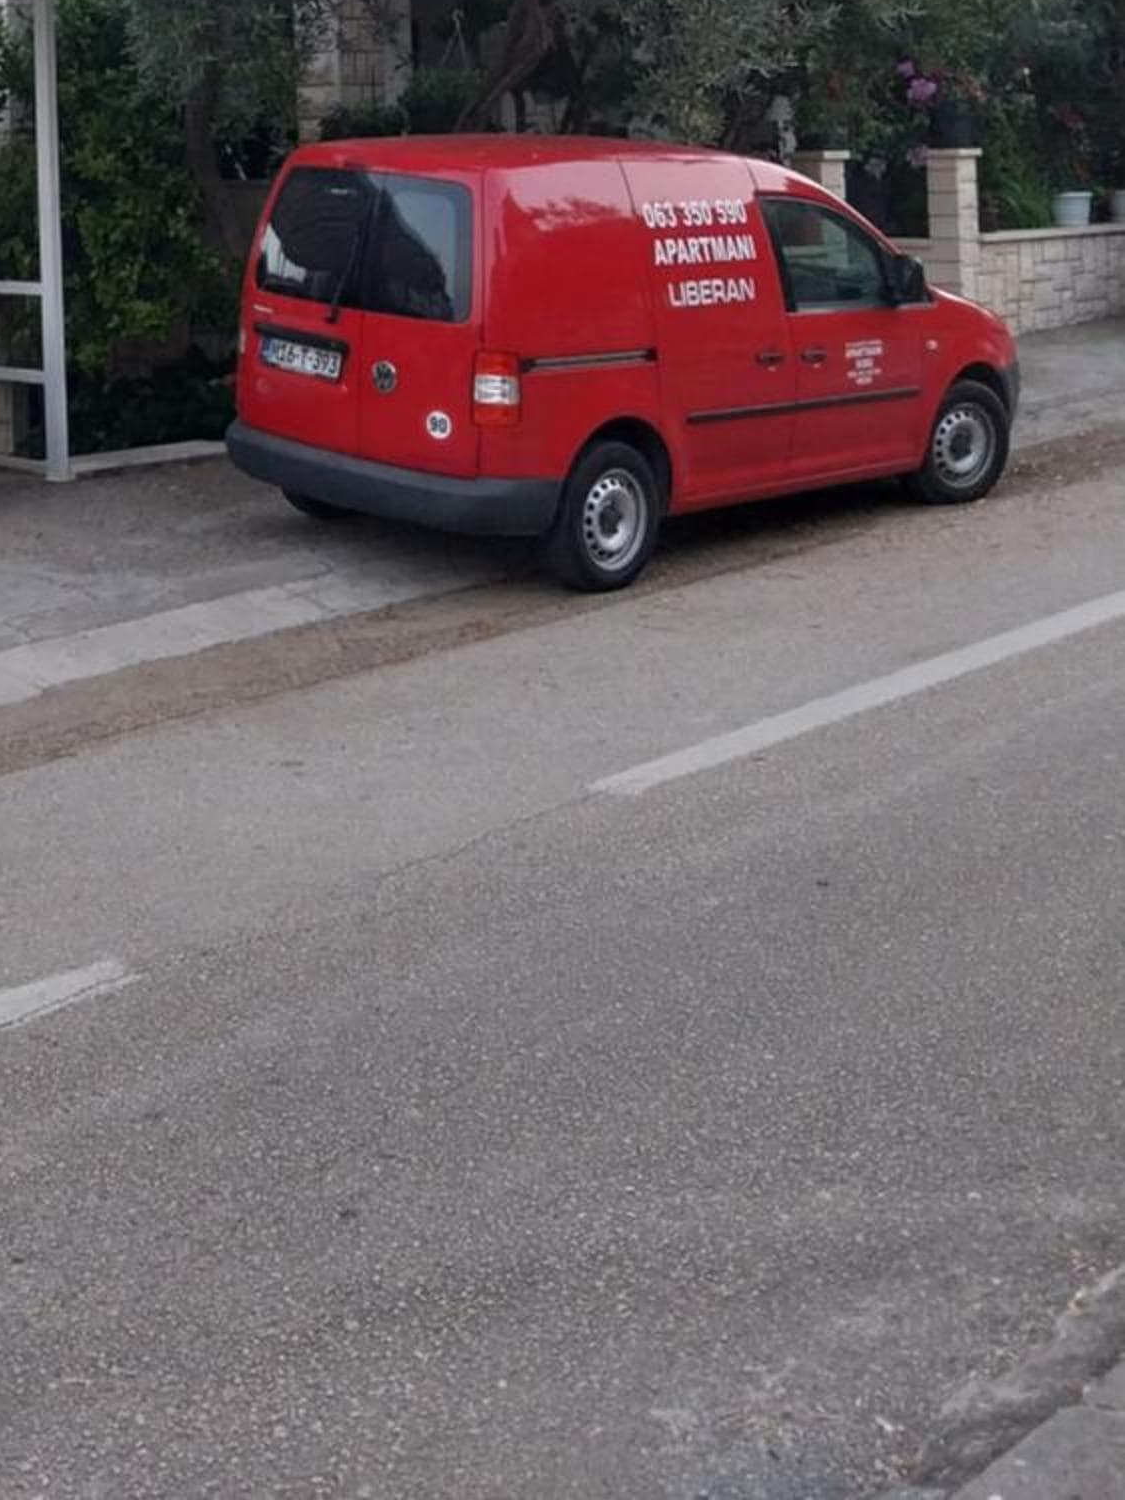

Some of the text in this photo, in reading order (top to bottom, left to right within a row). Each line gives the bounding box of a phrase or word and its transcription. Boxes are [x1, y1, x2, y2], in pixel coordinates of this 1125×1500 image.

[643, 201, 677, 228] 063
[654, 235, 756, 266] APARTMANI
[668, 277, 755, 307] LIBERAN
